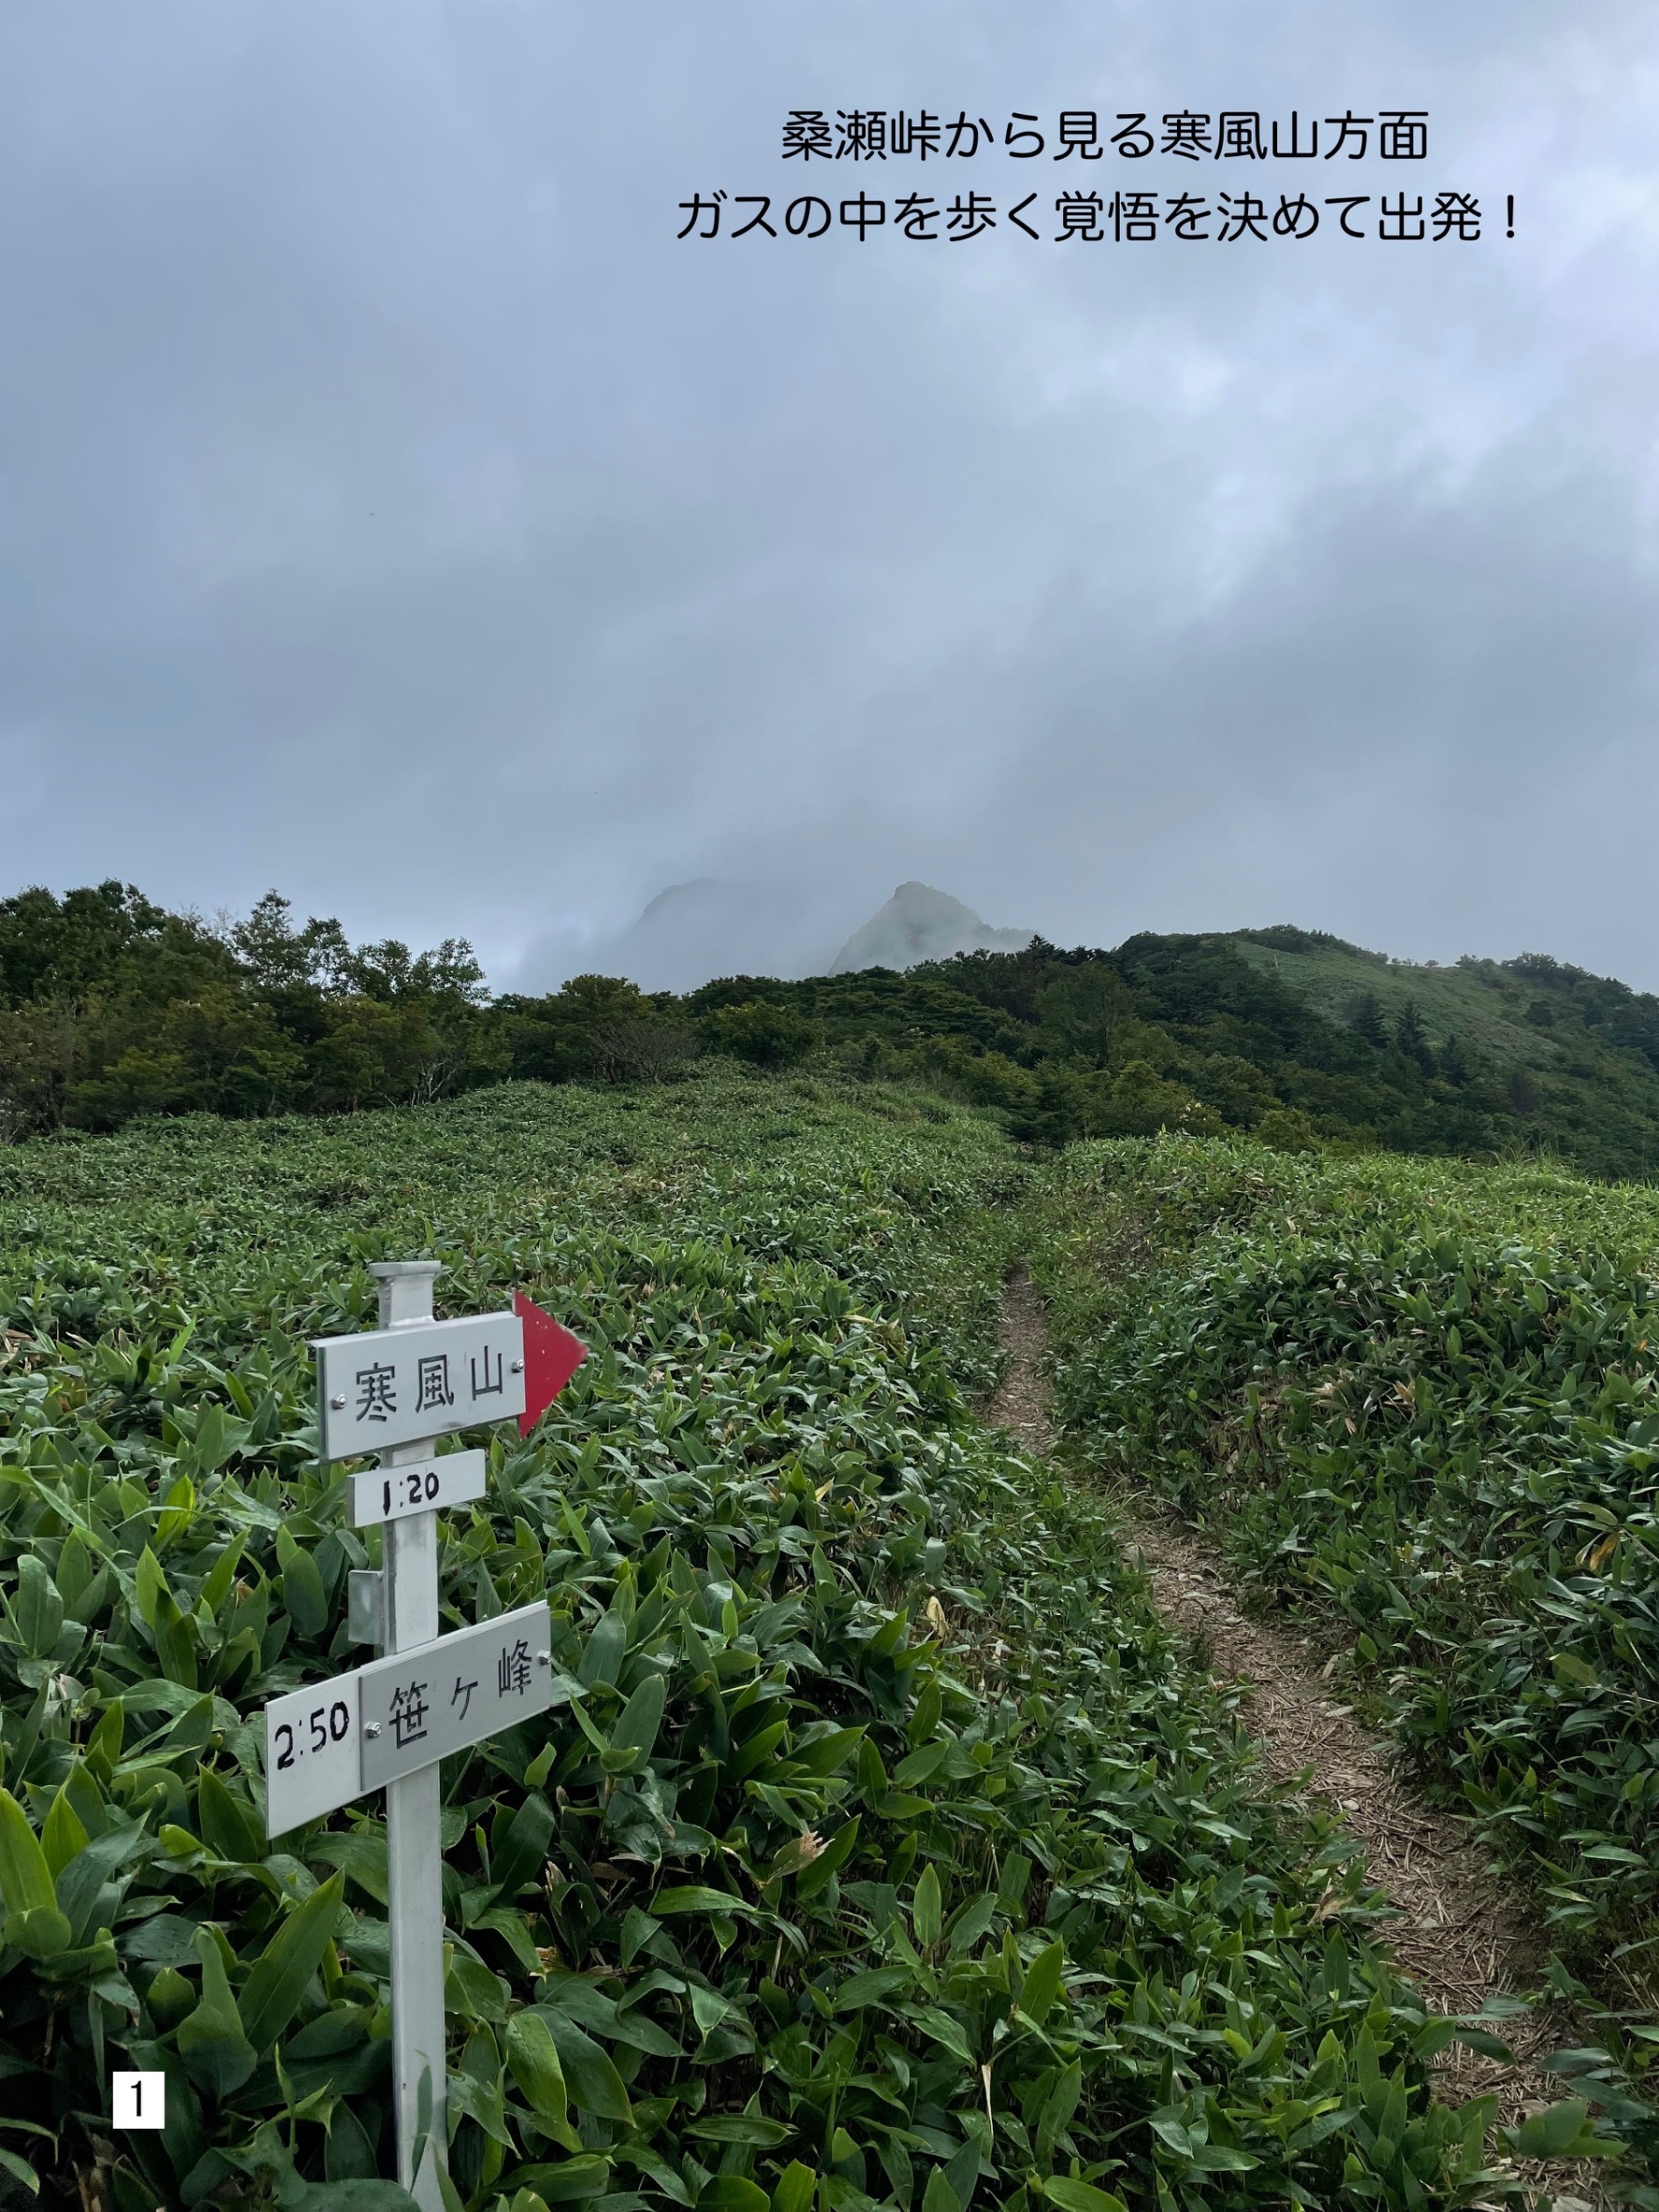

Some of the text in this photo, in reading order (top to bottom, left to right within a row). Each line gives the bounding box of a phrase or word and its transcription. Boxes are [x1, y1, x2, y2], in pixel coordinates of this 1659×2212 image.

[356, 1345, 503, 1422] 寒風山
[382, 1472, 440, 1517] 1:20
[274, 1701, 350, 1770] 2:50
